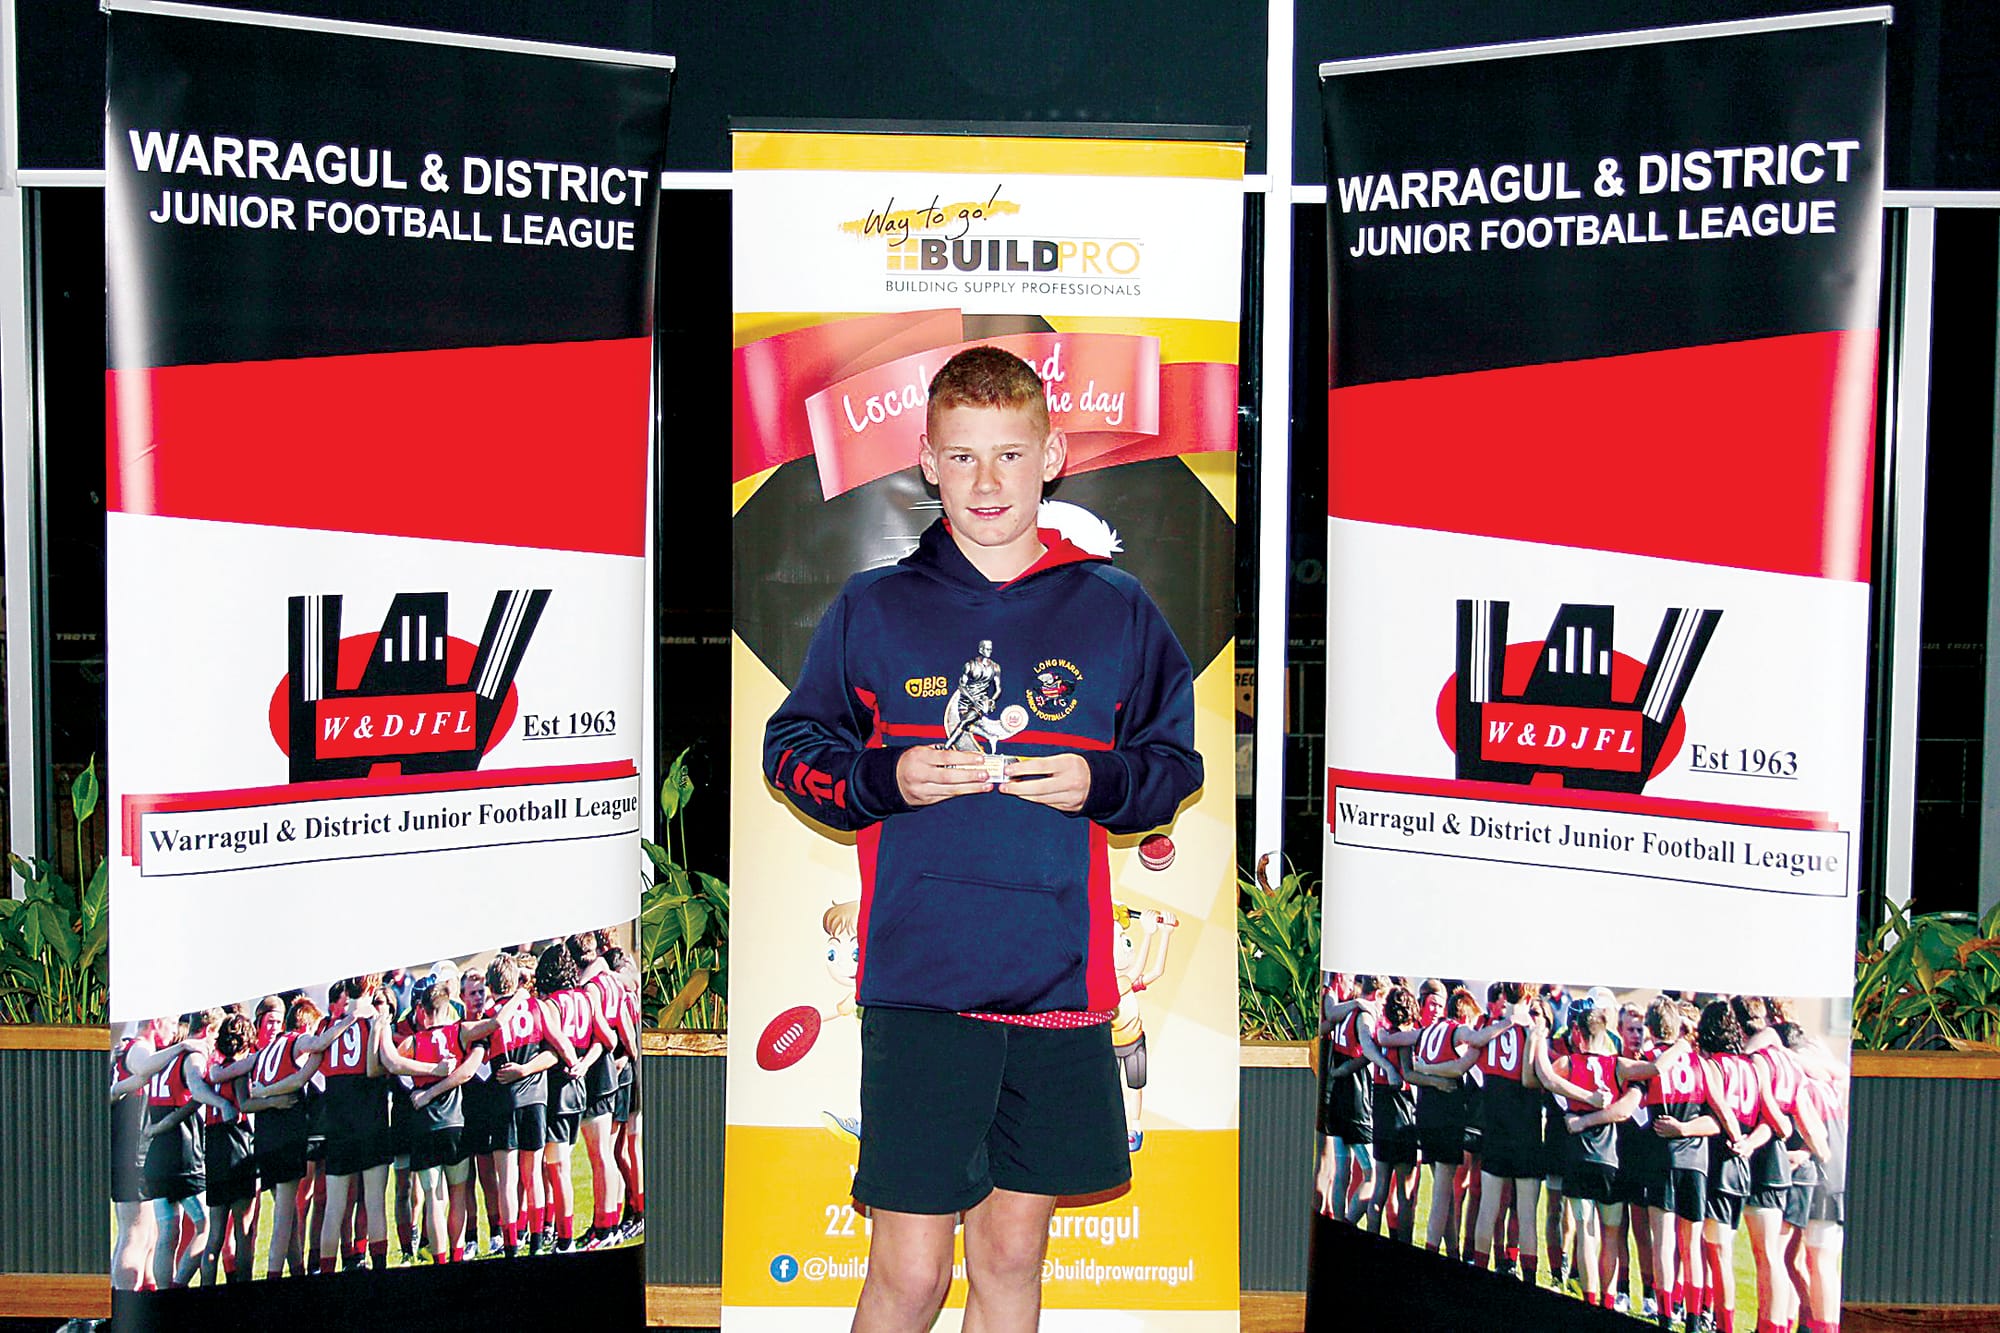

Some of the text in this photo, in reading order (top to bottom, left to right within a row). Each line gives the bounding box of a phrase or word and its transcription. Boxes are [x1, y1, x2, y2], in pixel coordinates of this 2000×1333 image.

[129, 130, 648, 207] WARRAGUL & DISTRICT
[1338, 141, 1859, 214] WARRAGUL & DISTRICT
[150, 190, 635, 251] JUNIOR FOOTBALL LEAGUE
[864, 184, 1002, 247] Way to go!
[1350, 201, 1836, 258] JUNIOR FOOTBALL LEAGUE
[921, 238, 1140, 275] BUILDPRO
[886, 280, 1141, 296] BUILDING SUPPLY PROFESSIONALS
[1046, 380, 1126, 426] he day
[923, 676, 948, 690] BIG
[1033, 658, 1058, 674] LONG
[523, 709, 617, 738] Est 1963
[1690, 744, 1798, 776] Est 1963
[149, 794, 638, 853] Warragul & District Junior Football League
[1338, 802, 1839, 876] Warragul & District Junior Football League
[558, 991, 591, 1040] 20
[256, 1036, 288, 1083] 10
[1419, 1020, 1448, 1061] 10
[1722, 1056, 1758, 1115] 20
[825, 1205, 856, 1236] 22
[1048, 1206, 1140, 1245] arragul
